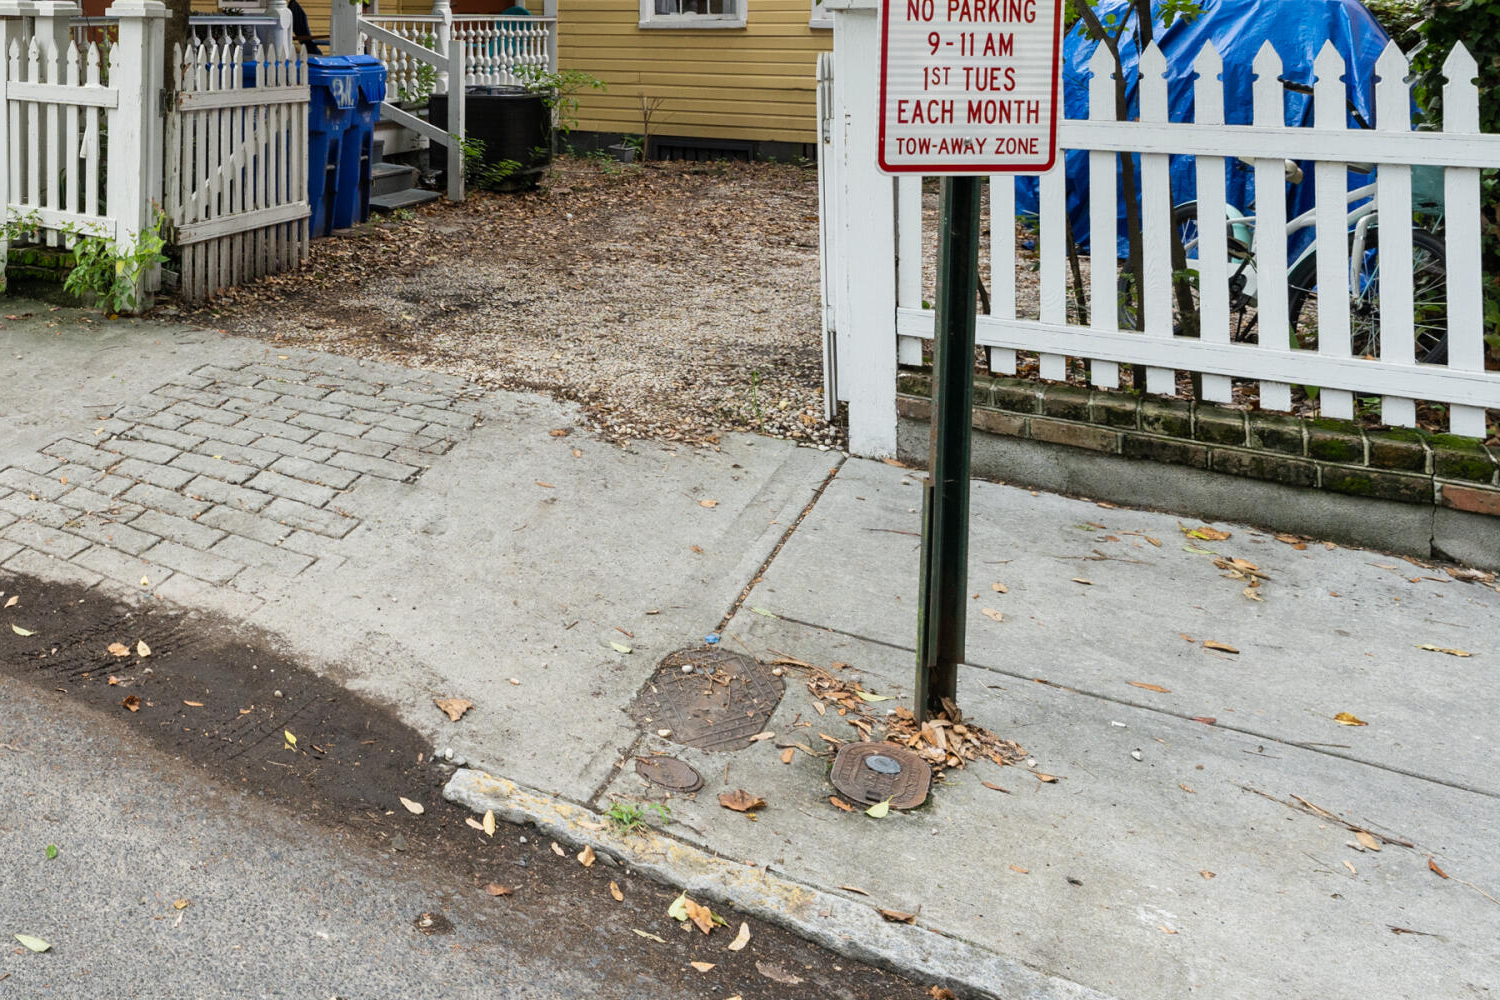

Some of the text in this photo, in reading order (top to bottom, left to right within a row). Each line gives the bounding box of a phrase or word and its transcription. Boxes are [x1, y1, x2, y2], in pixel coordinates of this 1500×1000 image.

[983, 32, 1014, 57] AM
[923, 66, 1016, 92] 1ST TUES
[897, 99, 1040, 125] EACH MONTH
[896, 137, 1040, 155] TOW-AWAY ZONE
